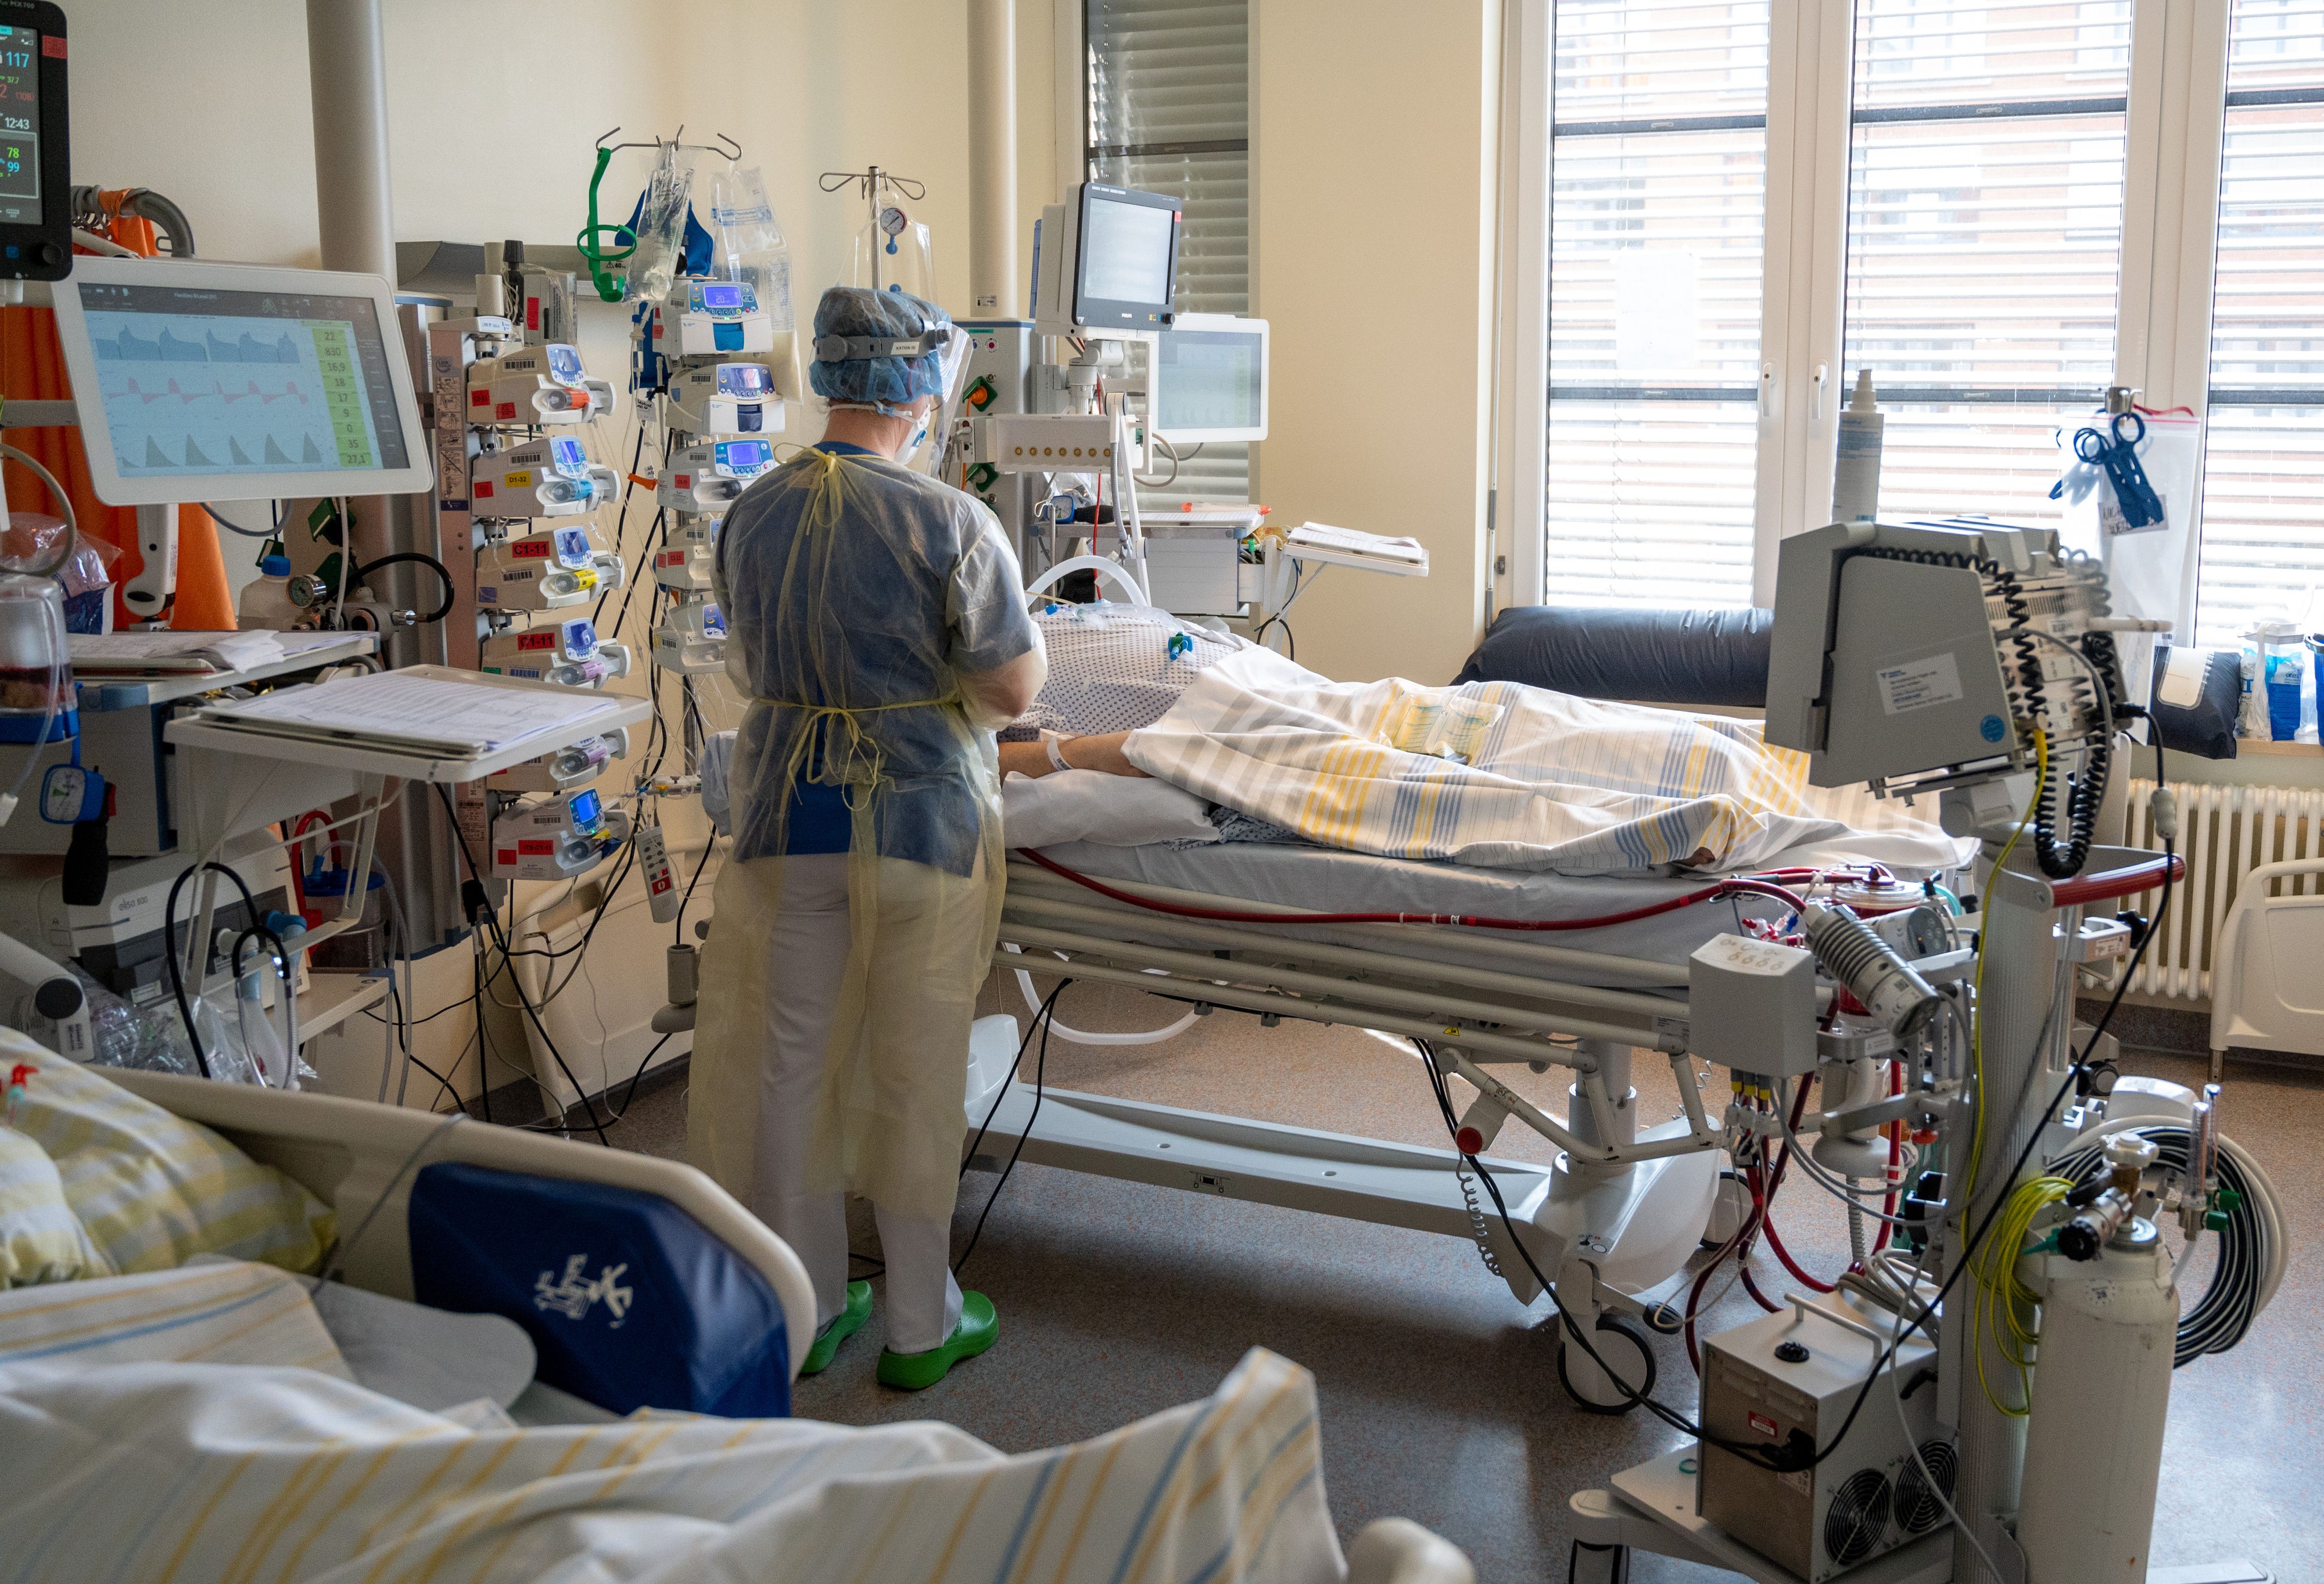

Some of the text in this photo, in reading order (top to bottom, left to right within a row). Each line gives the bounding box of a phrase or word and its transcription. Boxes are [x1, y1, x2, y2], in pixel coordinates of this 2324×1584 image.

[6, 52, 29, 68] 117
[5, 117, 30, 130] 12:43
[7, 147, 19, 159] 78
[7, 161, 20, 173] 99
[325, 332, 335, 340] 22
[325, 348, 341, 356] 830
[327, 362, 346, 373] 16,9
[335, 378, 345, 386] 18
[338, 394, 348, 402] 17
[343, 409, 349, 417] 9
[346, 424, 353, 432] 0
[348, 440, 358, 448] 35
[514, 544, 547, 554] C1-11
[520, 635, 553, 647] C1-11
[119, 899, 135, 911] elisa
